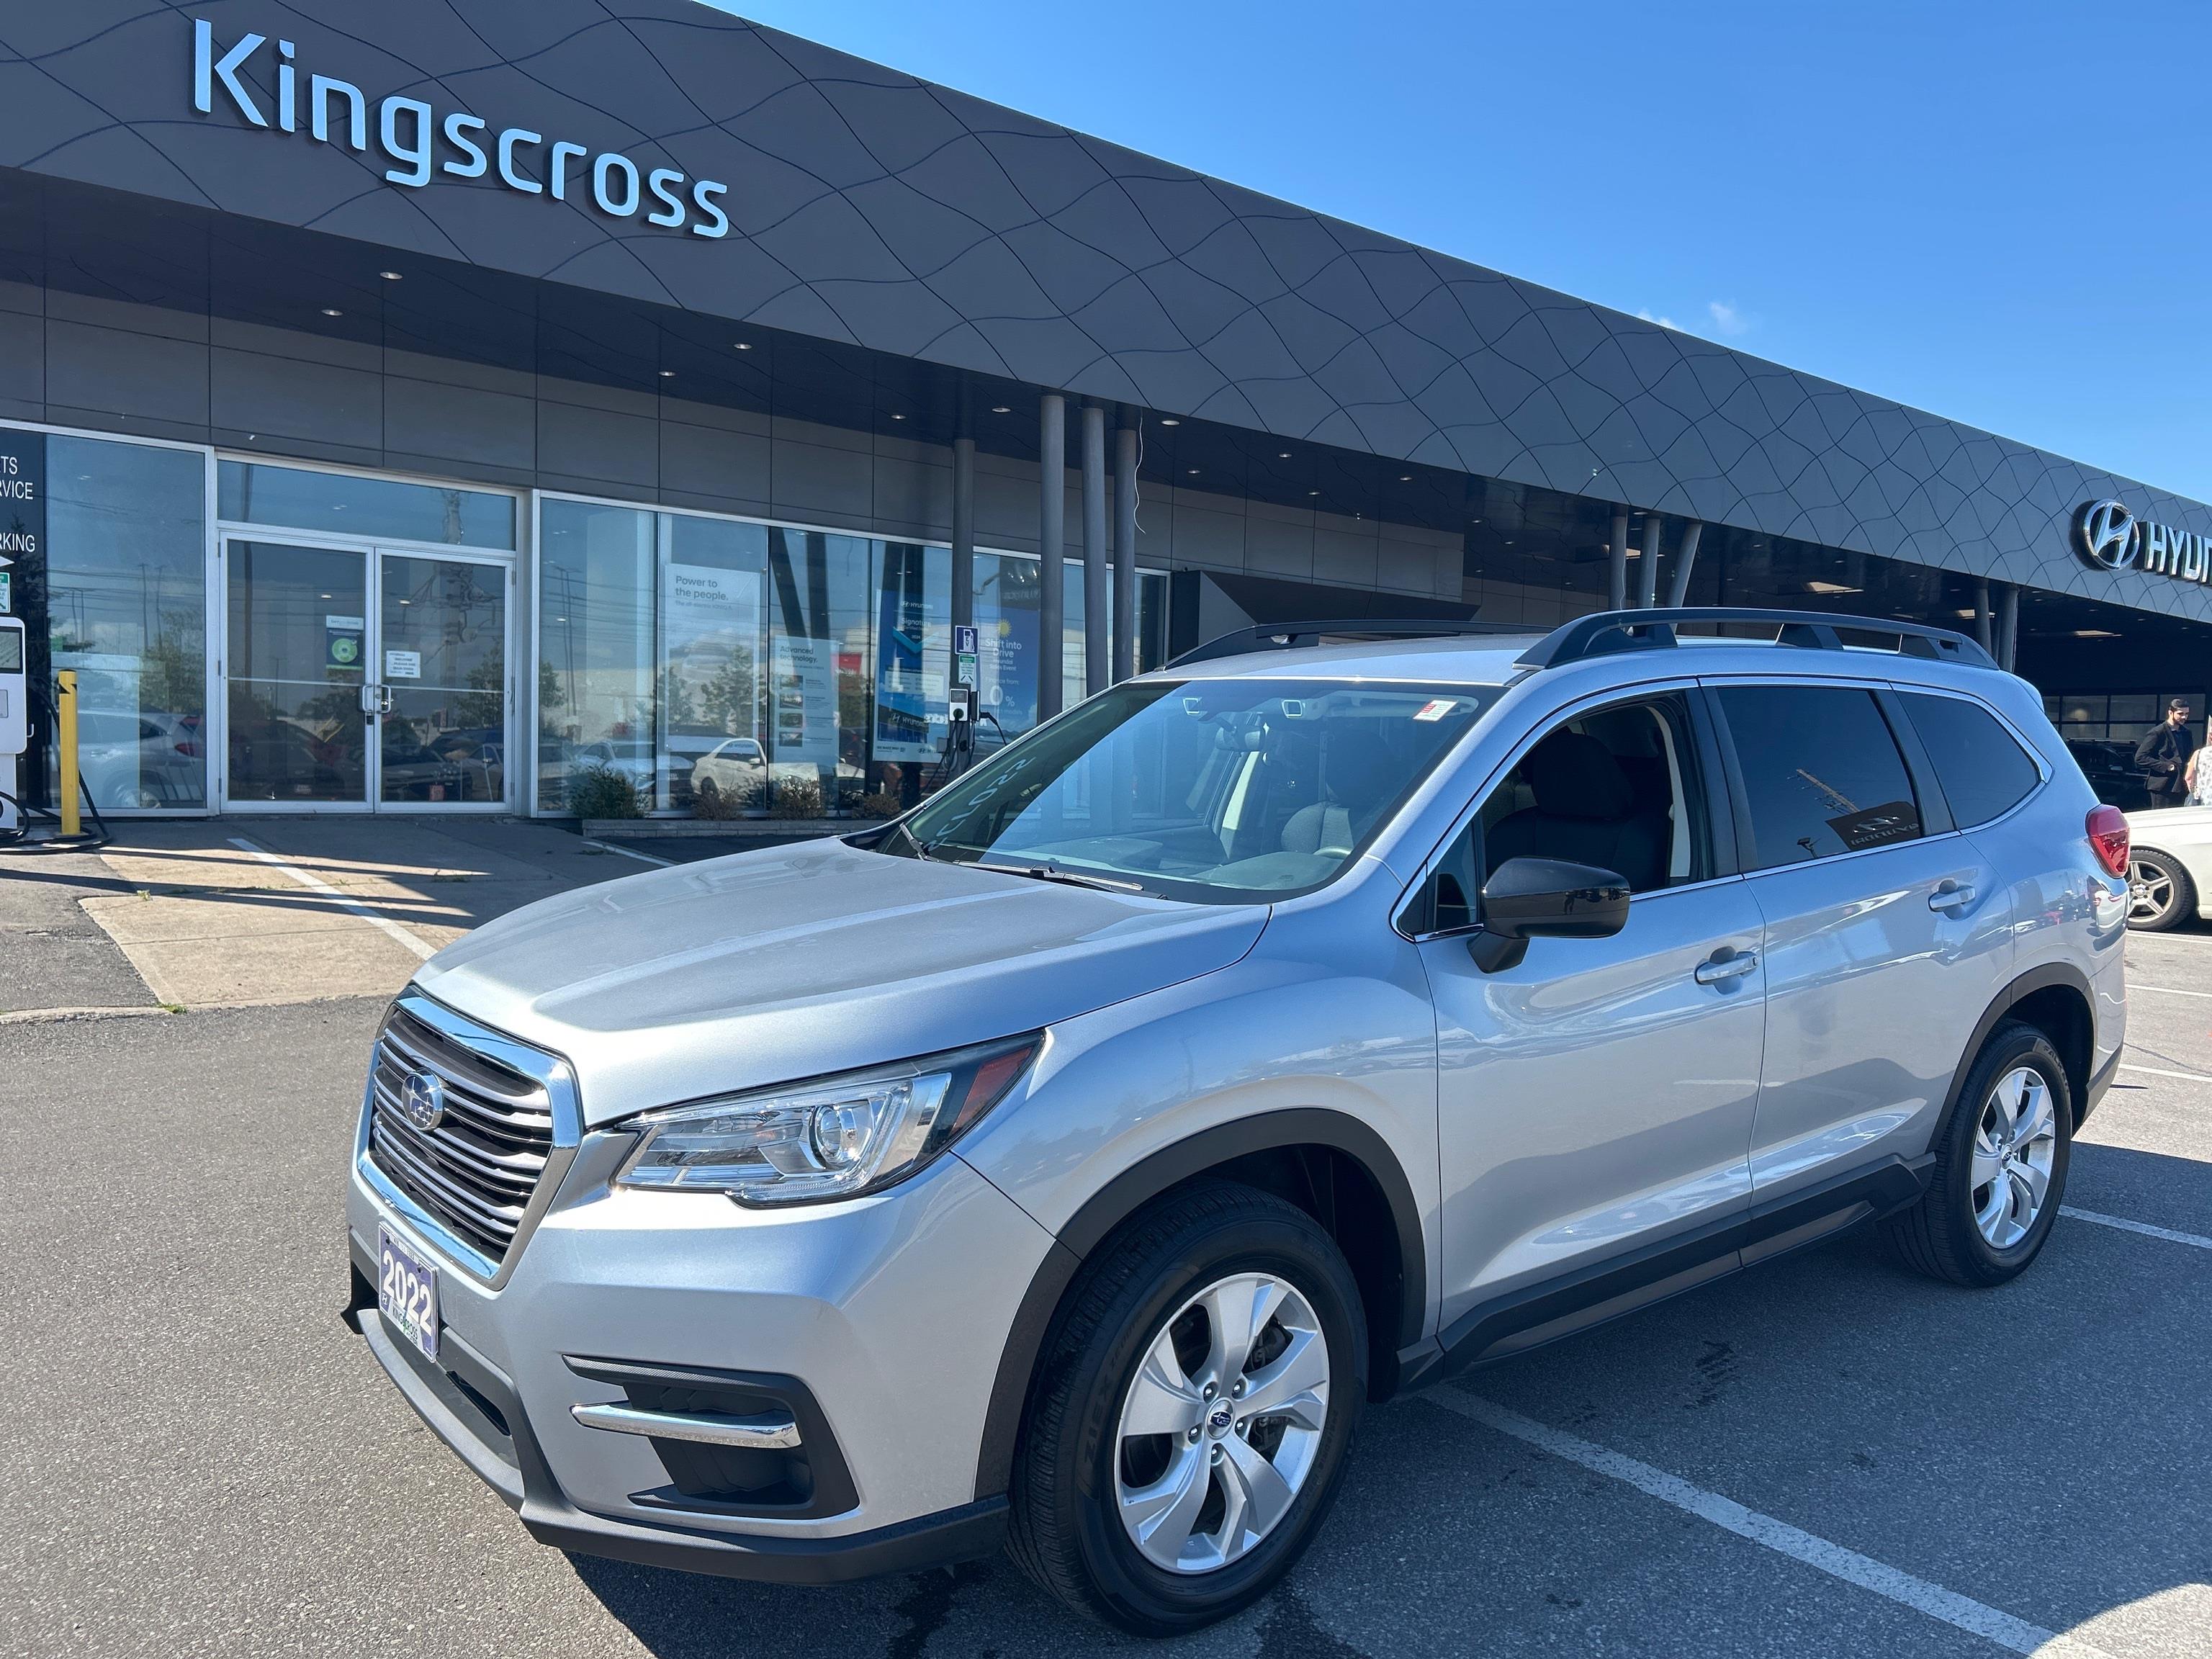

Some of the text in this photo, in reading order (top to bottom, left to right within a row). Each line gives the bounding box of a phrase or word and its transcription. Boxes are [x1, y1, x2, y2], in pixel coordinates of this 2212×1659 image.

[194, 18, 729, 238] Kingscross
[0, 456, 18, 475] TS
[0, 480, 33, 500] VICE
[0, 532, 35, 552] KING
[675, 575, 718, 588] Power to
[675, 588, 729, 602] the people.
[780, 646, 814, 655] Advanced
[985, 638, 1022, 650] Shift into
[993, 647, 1015, 658] Drive
[989, 685, 1015, 707] 0 %
[383, 1249, 432, 1337] 2022
